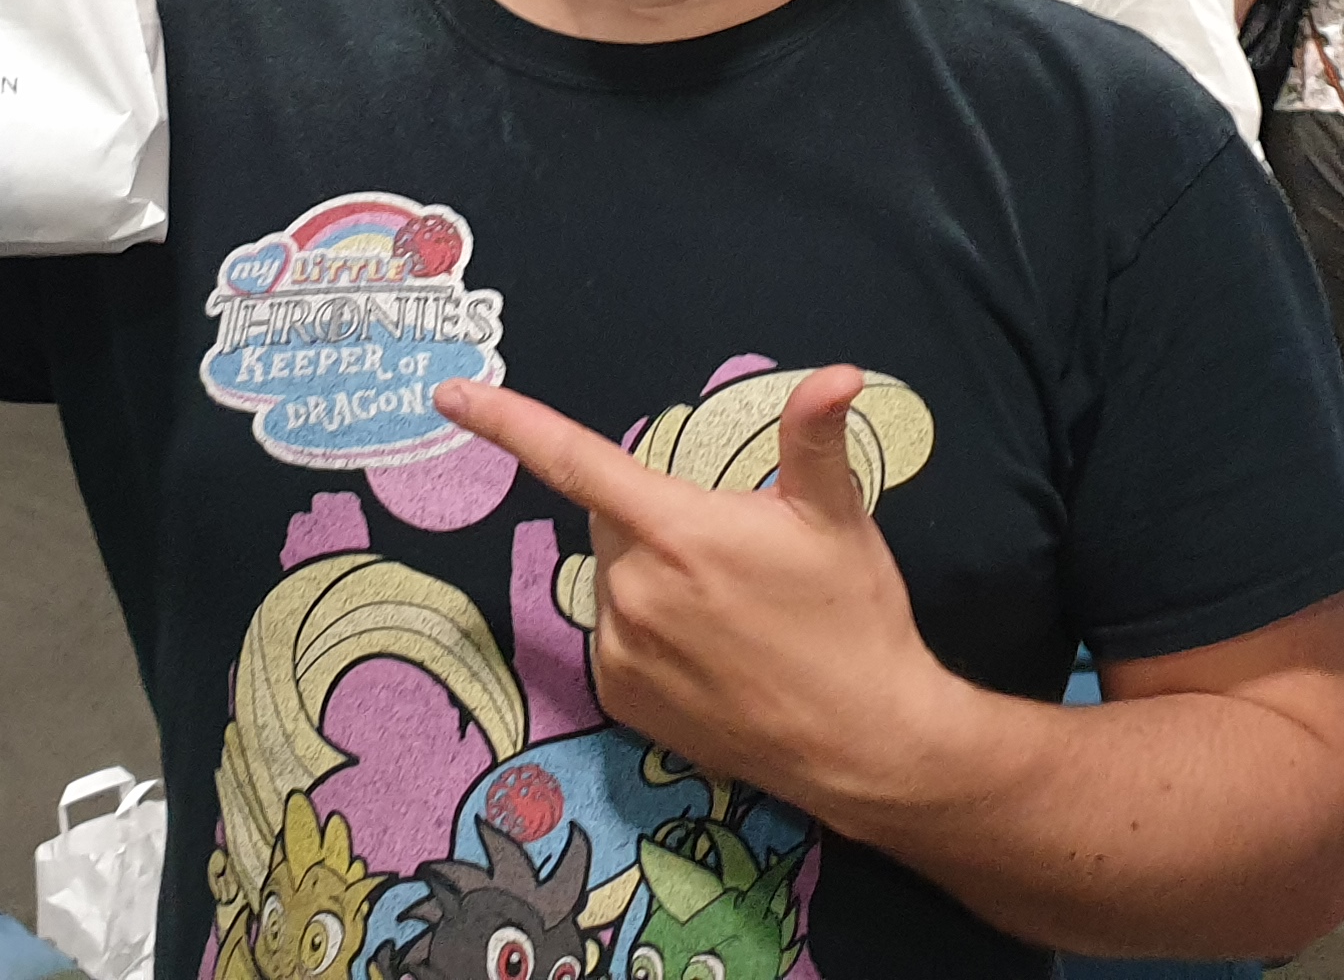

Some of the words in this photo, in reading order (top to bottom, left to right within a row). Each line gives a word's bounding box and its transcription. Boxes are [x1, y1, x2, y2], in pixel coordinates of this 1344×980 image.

[212, 286, 496, 353] THRONIES
[236, 343, 394, 383] KEEPER
[398, 352, 432, 376] OF
[286, 381, 440, 432] DRAGON
